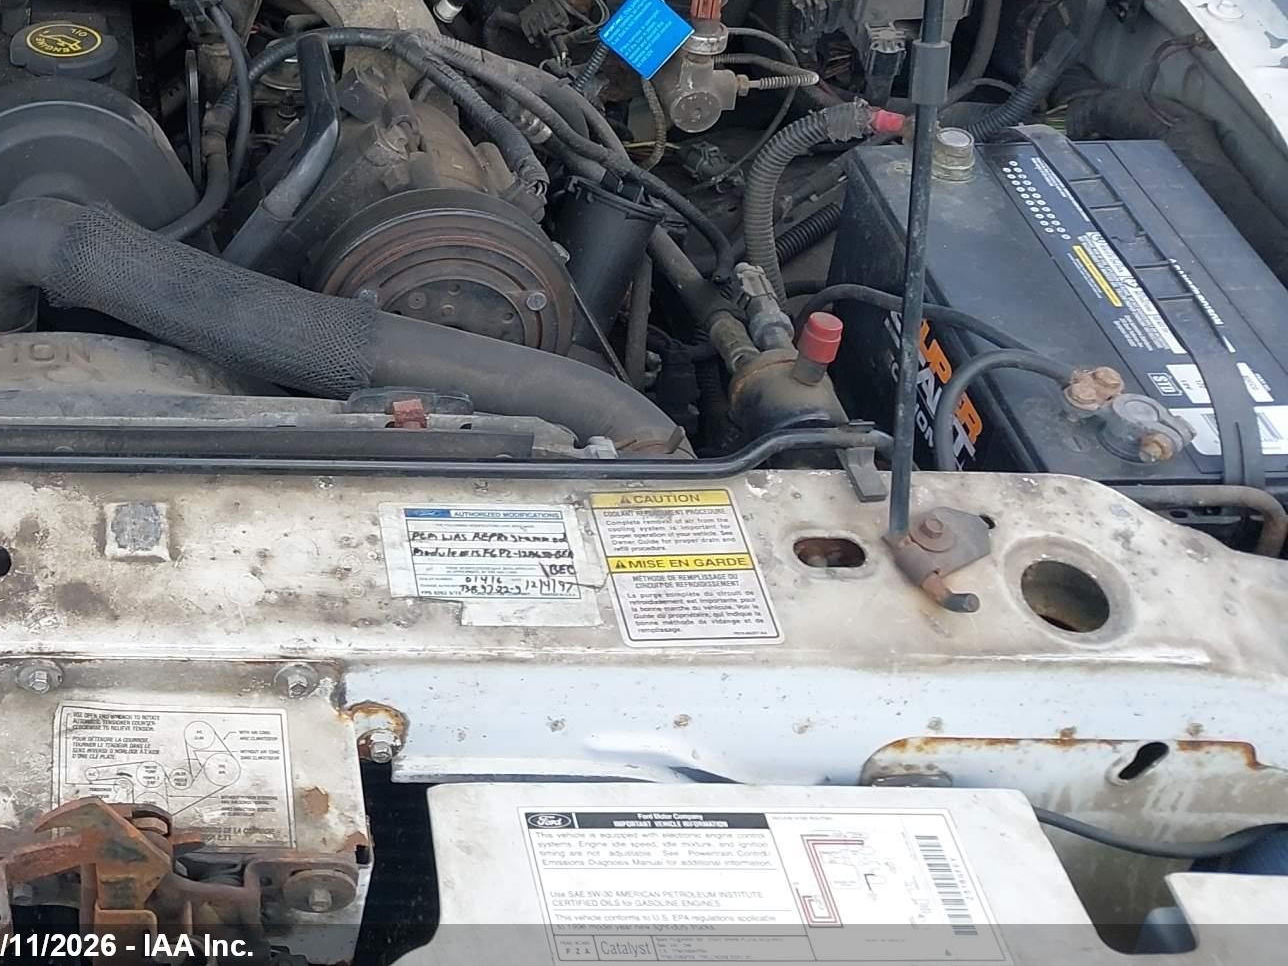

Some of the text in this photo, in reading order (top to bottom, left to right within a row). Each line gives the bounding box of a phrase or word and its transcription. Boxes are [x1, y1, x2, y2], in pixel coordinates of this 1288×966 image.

[35, 37, 70, 53] ENGINE
[1152, 375, 1177, 394] STD
[634, 495, 700, 504] CAUTION
[629, 557, 748, 568] MISE EN GARDE
[537, 816, 563, 826] Ford
[601, 941, 652, 957] Catalyst
